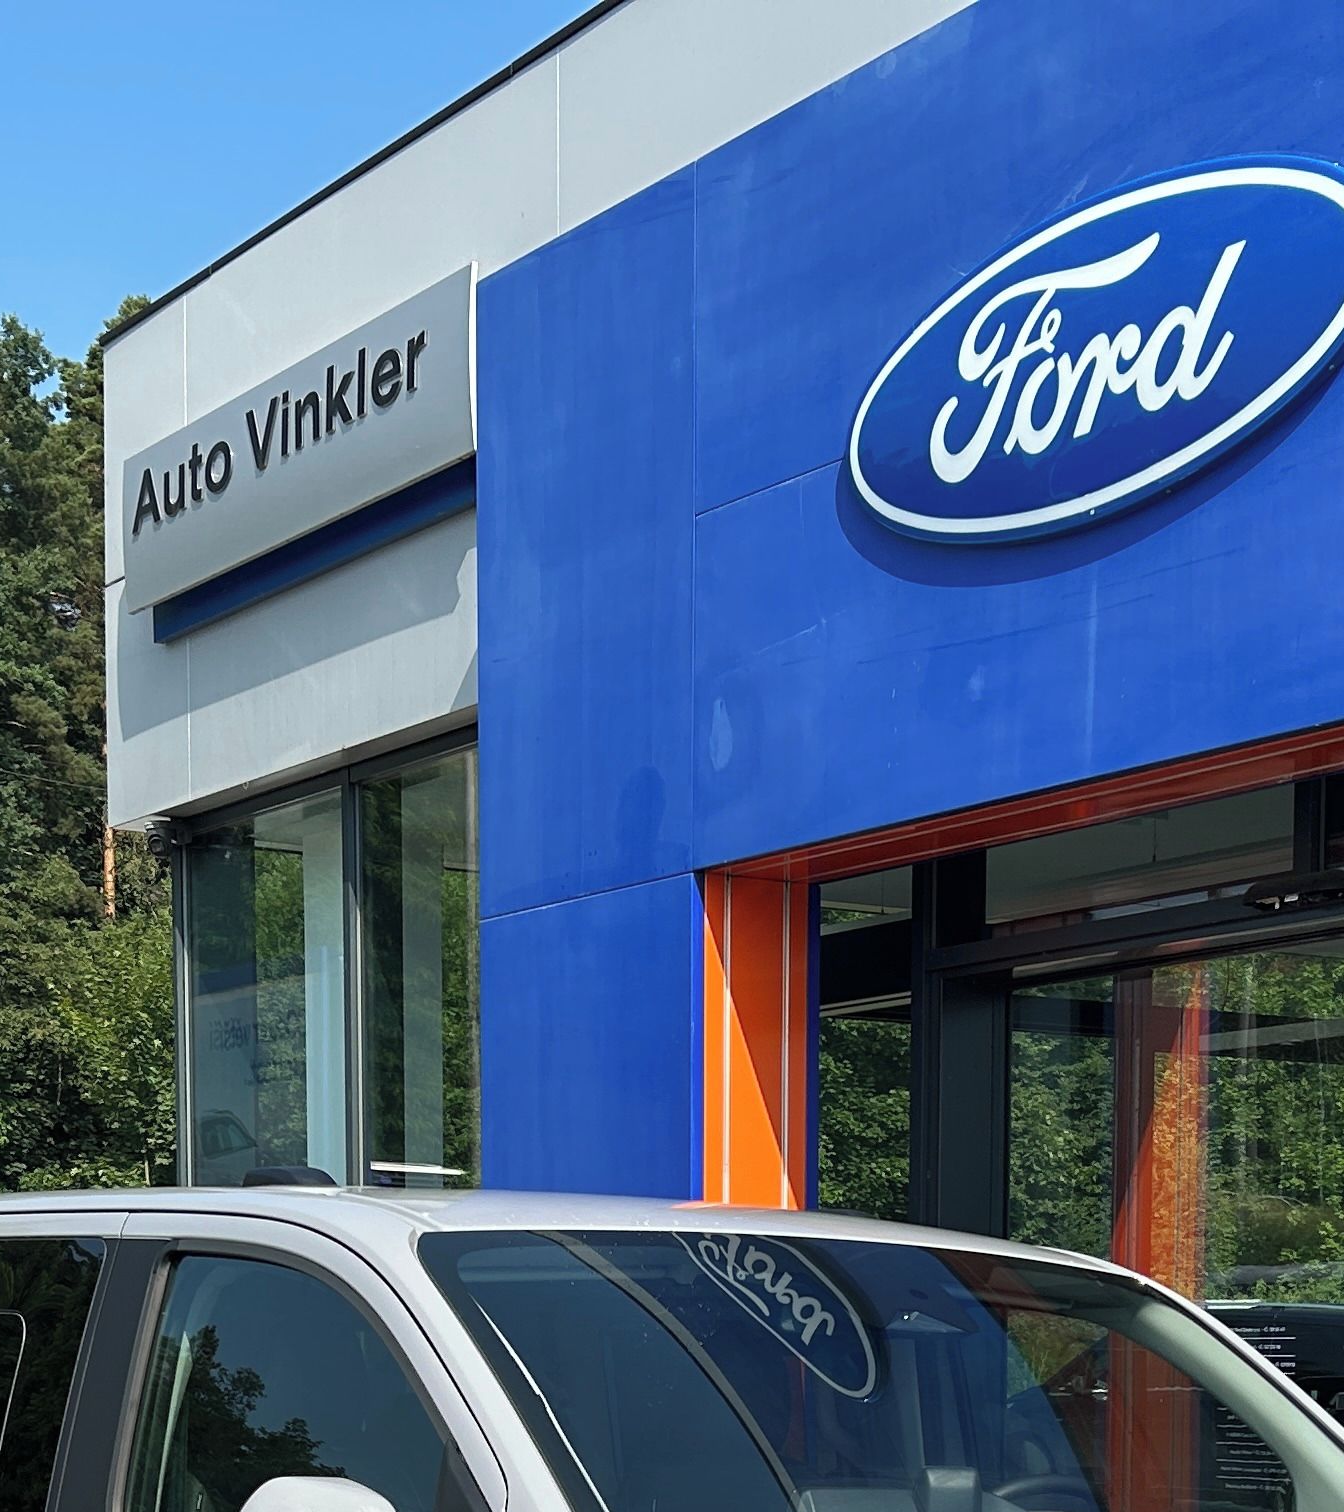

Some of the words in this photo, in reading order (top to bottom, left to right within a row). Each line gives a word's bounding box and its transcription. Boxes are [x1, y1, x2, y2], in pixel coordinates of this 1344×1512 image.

[131, 437, 234, 536] Auto
[245, 329, 428, 472] Vinkler
[929, 230, 1247, 485] Ford
